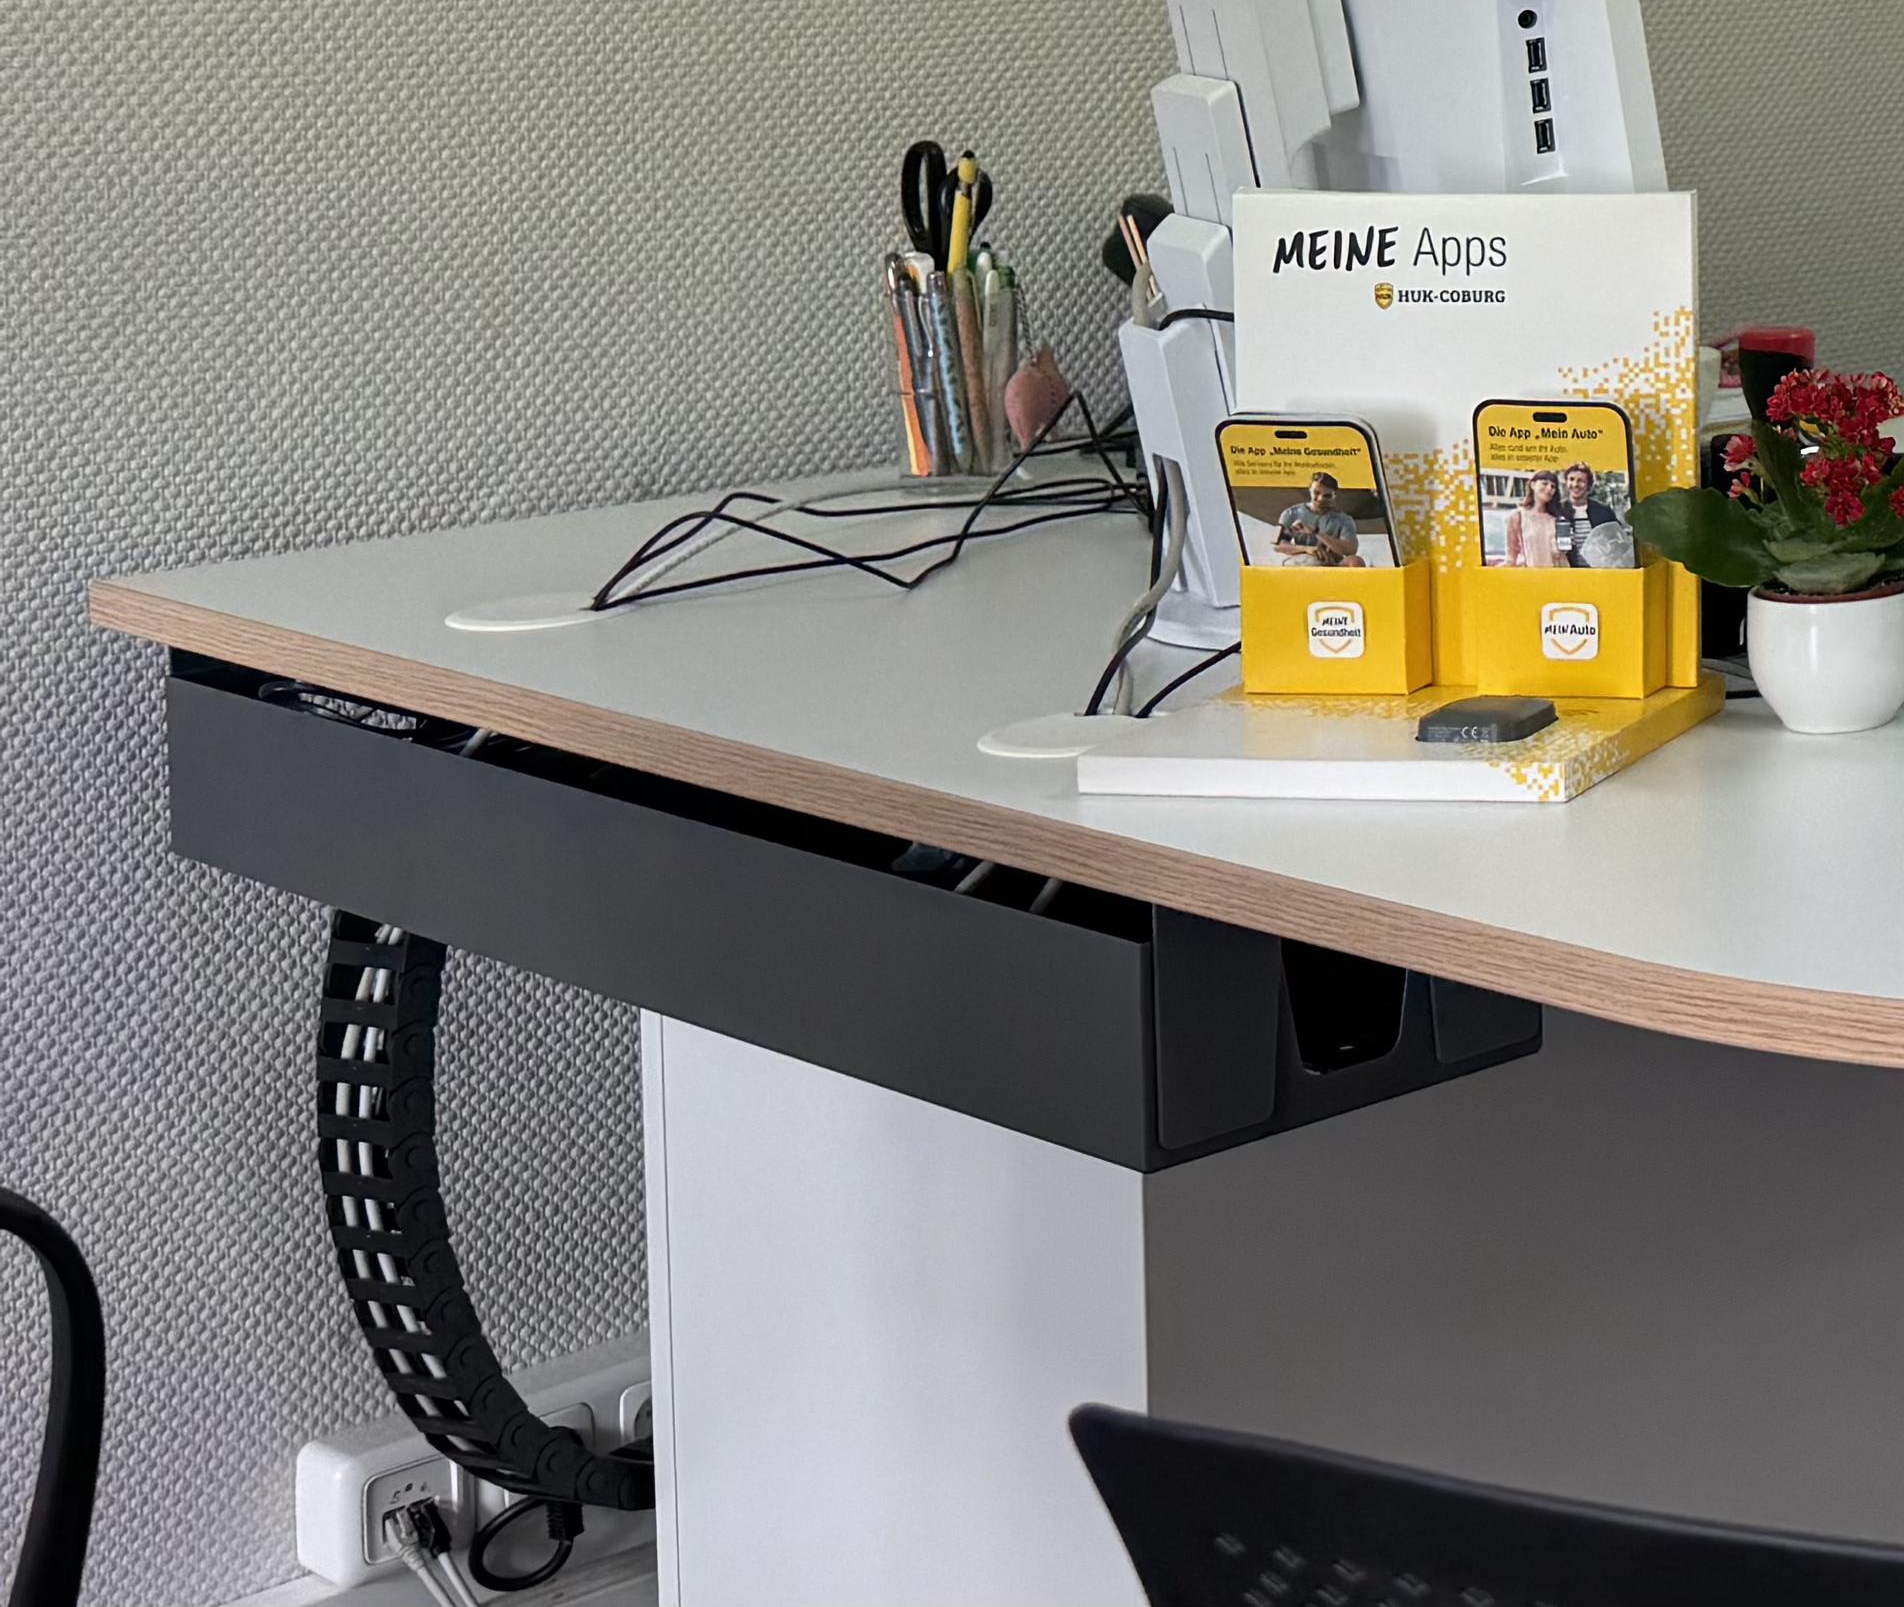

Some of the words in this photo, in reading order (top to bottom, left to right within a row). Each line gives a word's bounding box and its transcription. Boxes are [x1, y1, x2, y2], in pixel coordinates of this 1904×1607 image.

[1272, 225, 1399, 274] MEINE
[1412, 226, 1507, 276] Apps
[1398, 290, 1506, 303] HUK-COBURG
[1489, 426, 1506, 438] Die
[1510, 427, 1531, 440] App
[1230, 445, 1245, 455] Die
[1248, 446, 1266, 457] App
[1311, 627, 1361, 637] Gesundheit
[1570, 624, 1596, 635] Auto
